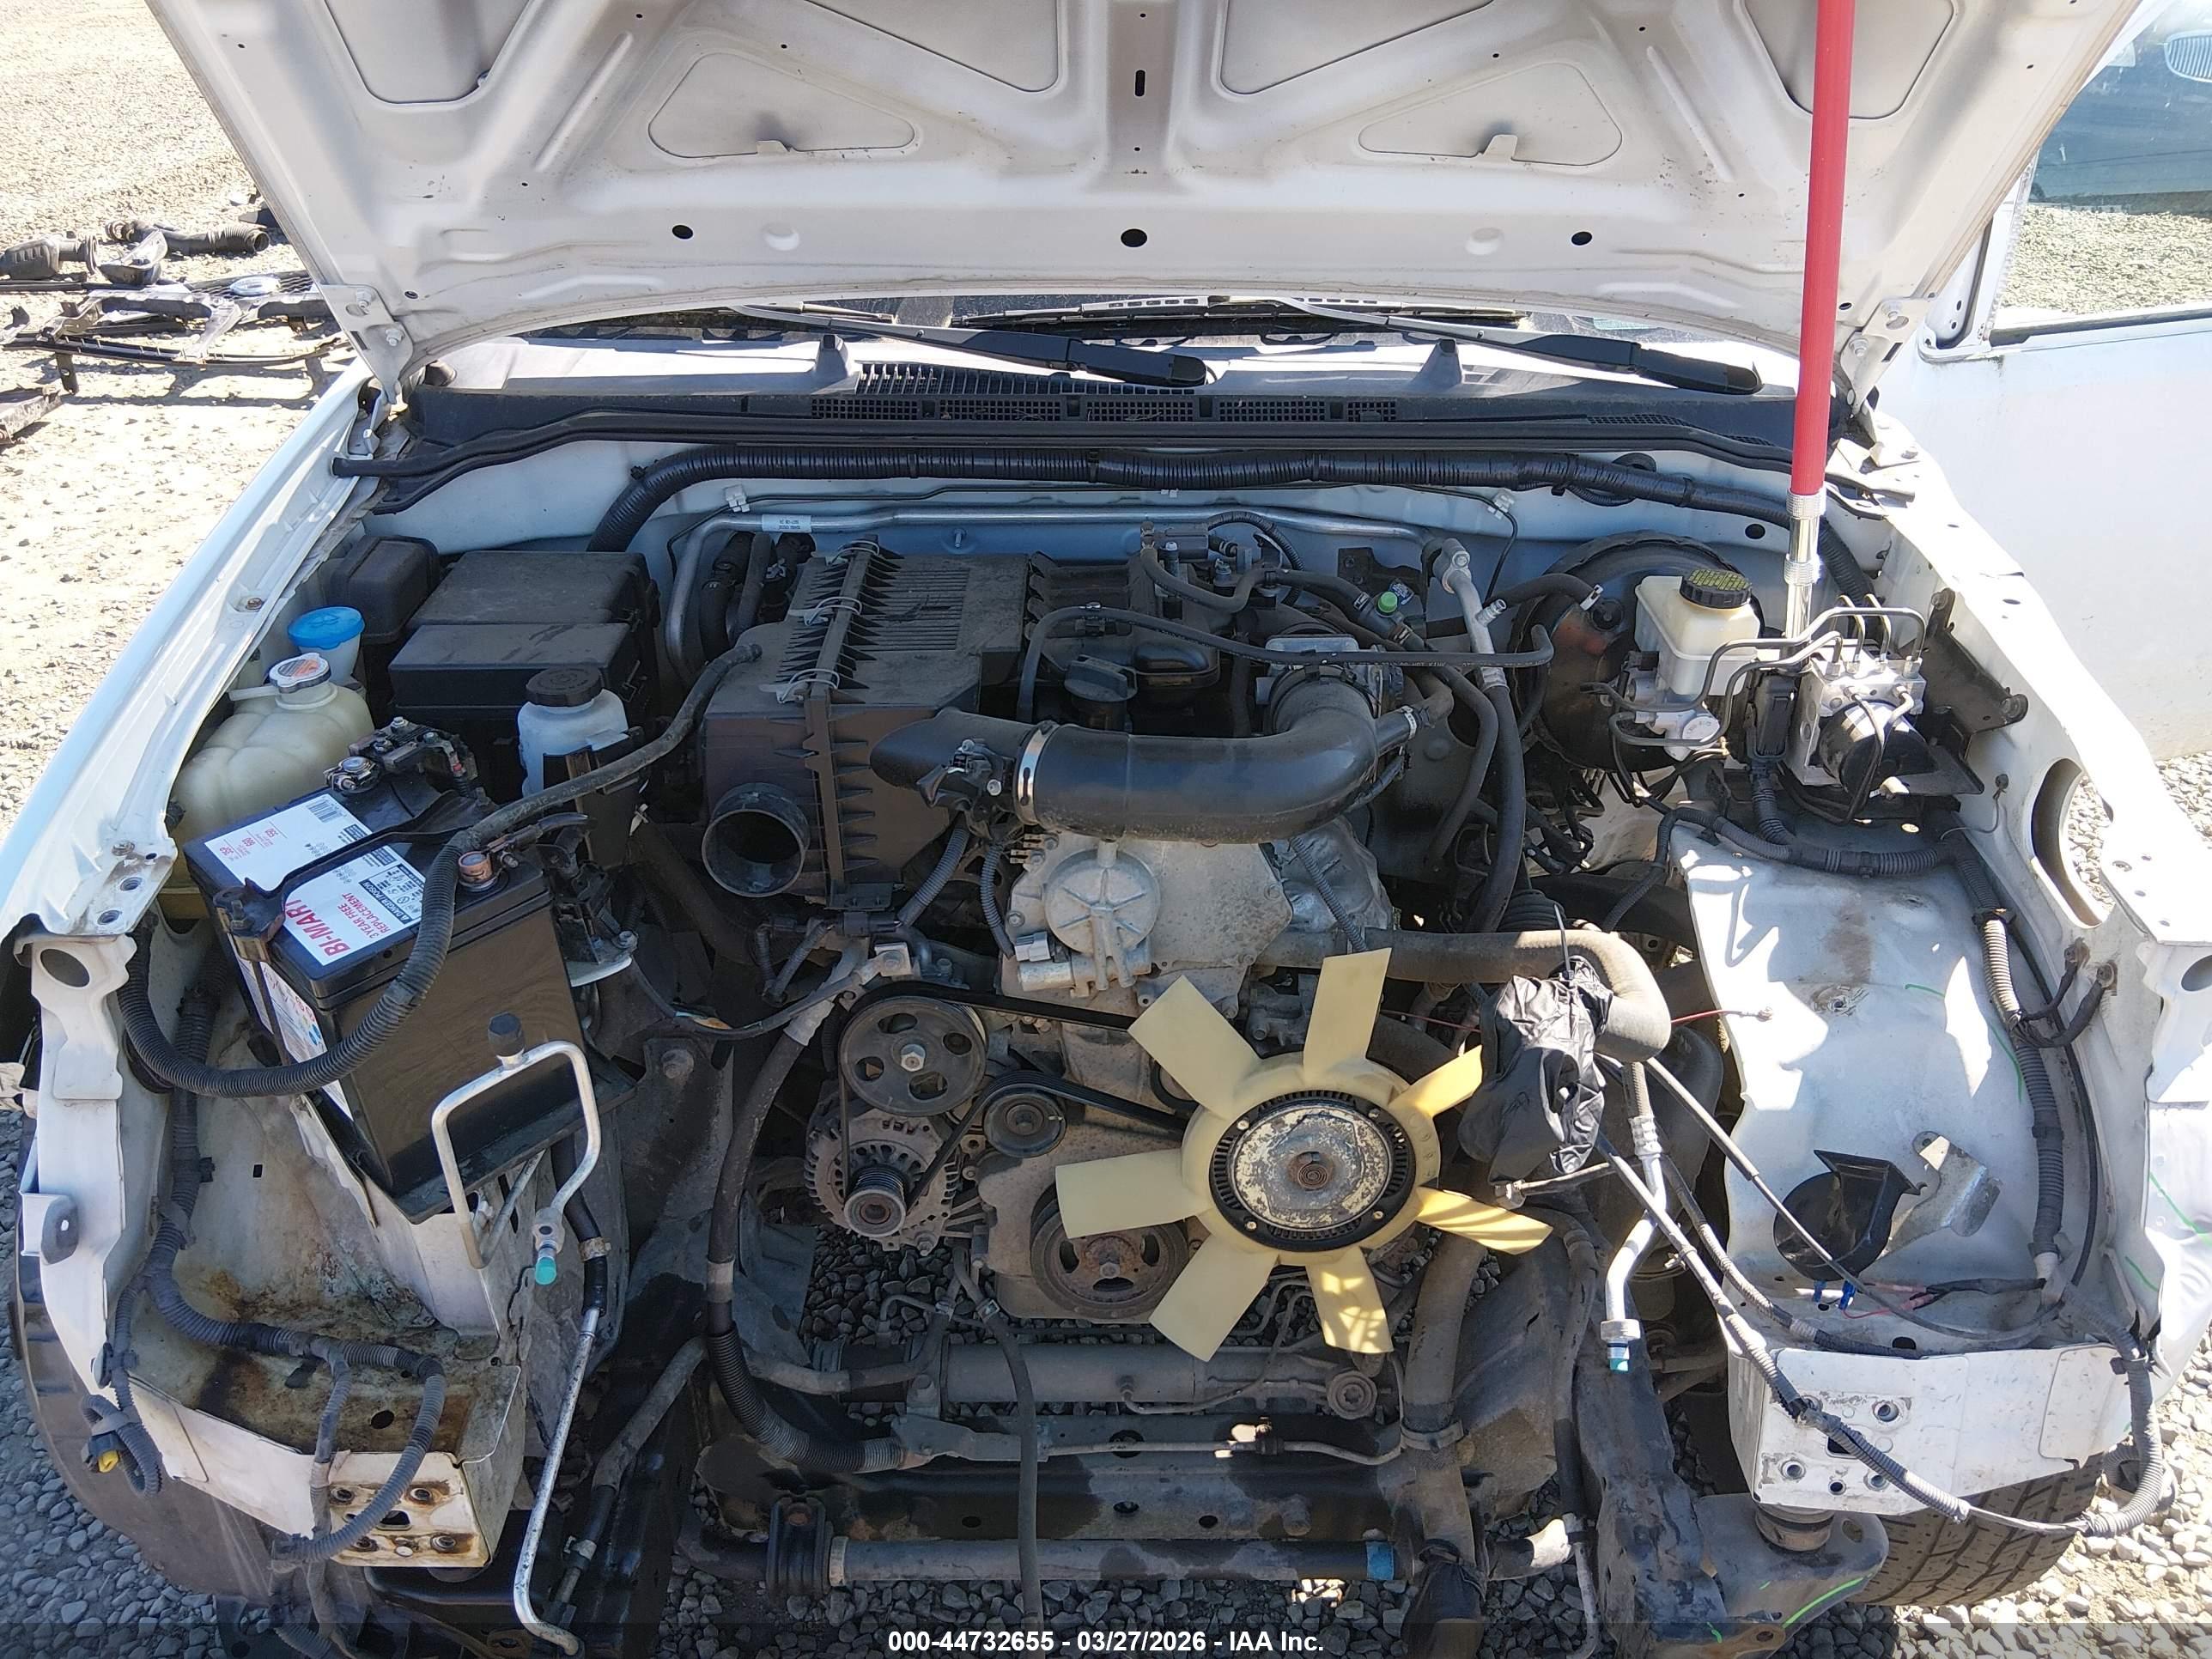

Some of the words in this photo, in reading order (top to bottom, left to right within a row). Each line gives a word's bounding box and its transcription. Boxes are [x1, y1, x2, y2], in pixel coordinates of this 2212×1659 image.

[362, 881, 383, 899] POISON
[337, 903, 358, 919] FREE
[342, 892, 391, 933] REPLACEMENT
[380, 898, 403, 917] DANGER
[353, 917, 374, 935] YEAR
